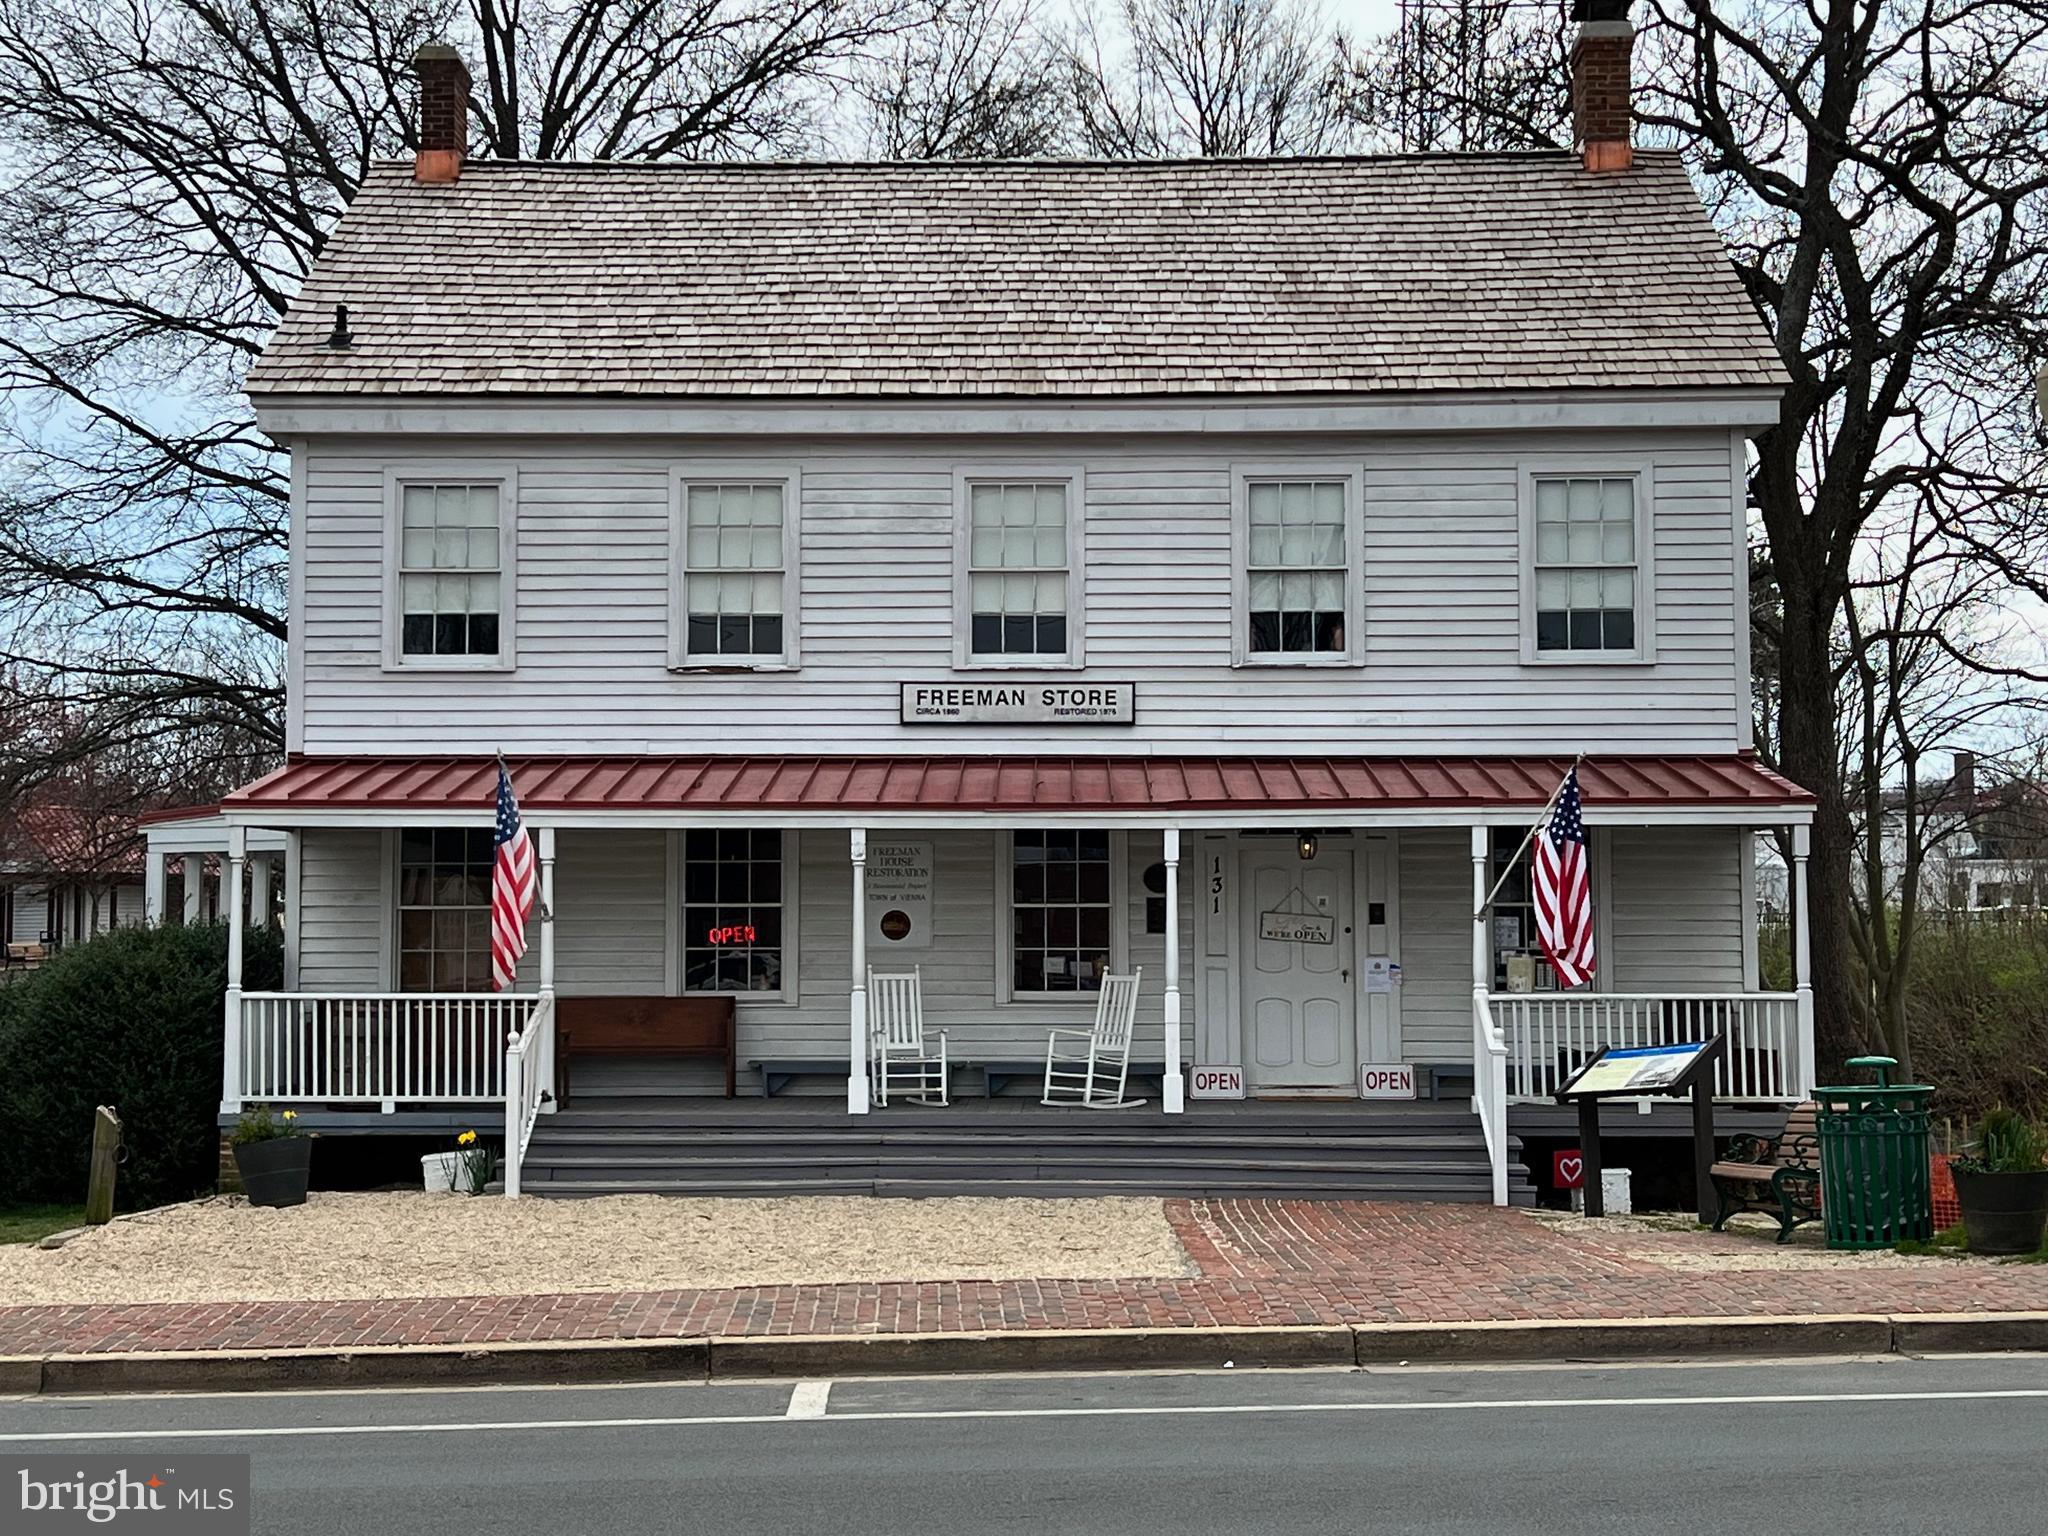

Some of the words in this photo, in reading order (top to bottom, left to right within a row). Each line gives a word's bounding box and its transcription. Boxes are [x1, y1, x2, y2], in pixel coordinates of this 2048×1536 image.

[917, 689, 1025, 706] FREEMAN
[1042, 689, 1117, 706] STORE
[916, 707, 940, 715] CIRCA
[1054, 708, 1097, 716] RESTORED
[873, 847, 921, 856] FREEMAN
[880, 857, 914, 866] HOUSE
[866, 868, 929, 877] RESTORATION
[709, 925, 755, 944] OPEN
[1294, 929, 1327, 941] OPEN
[1195, 1073, 1239, 1090] OPEN
[1366, 1071, 1410, 1090] OPEN
